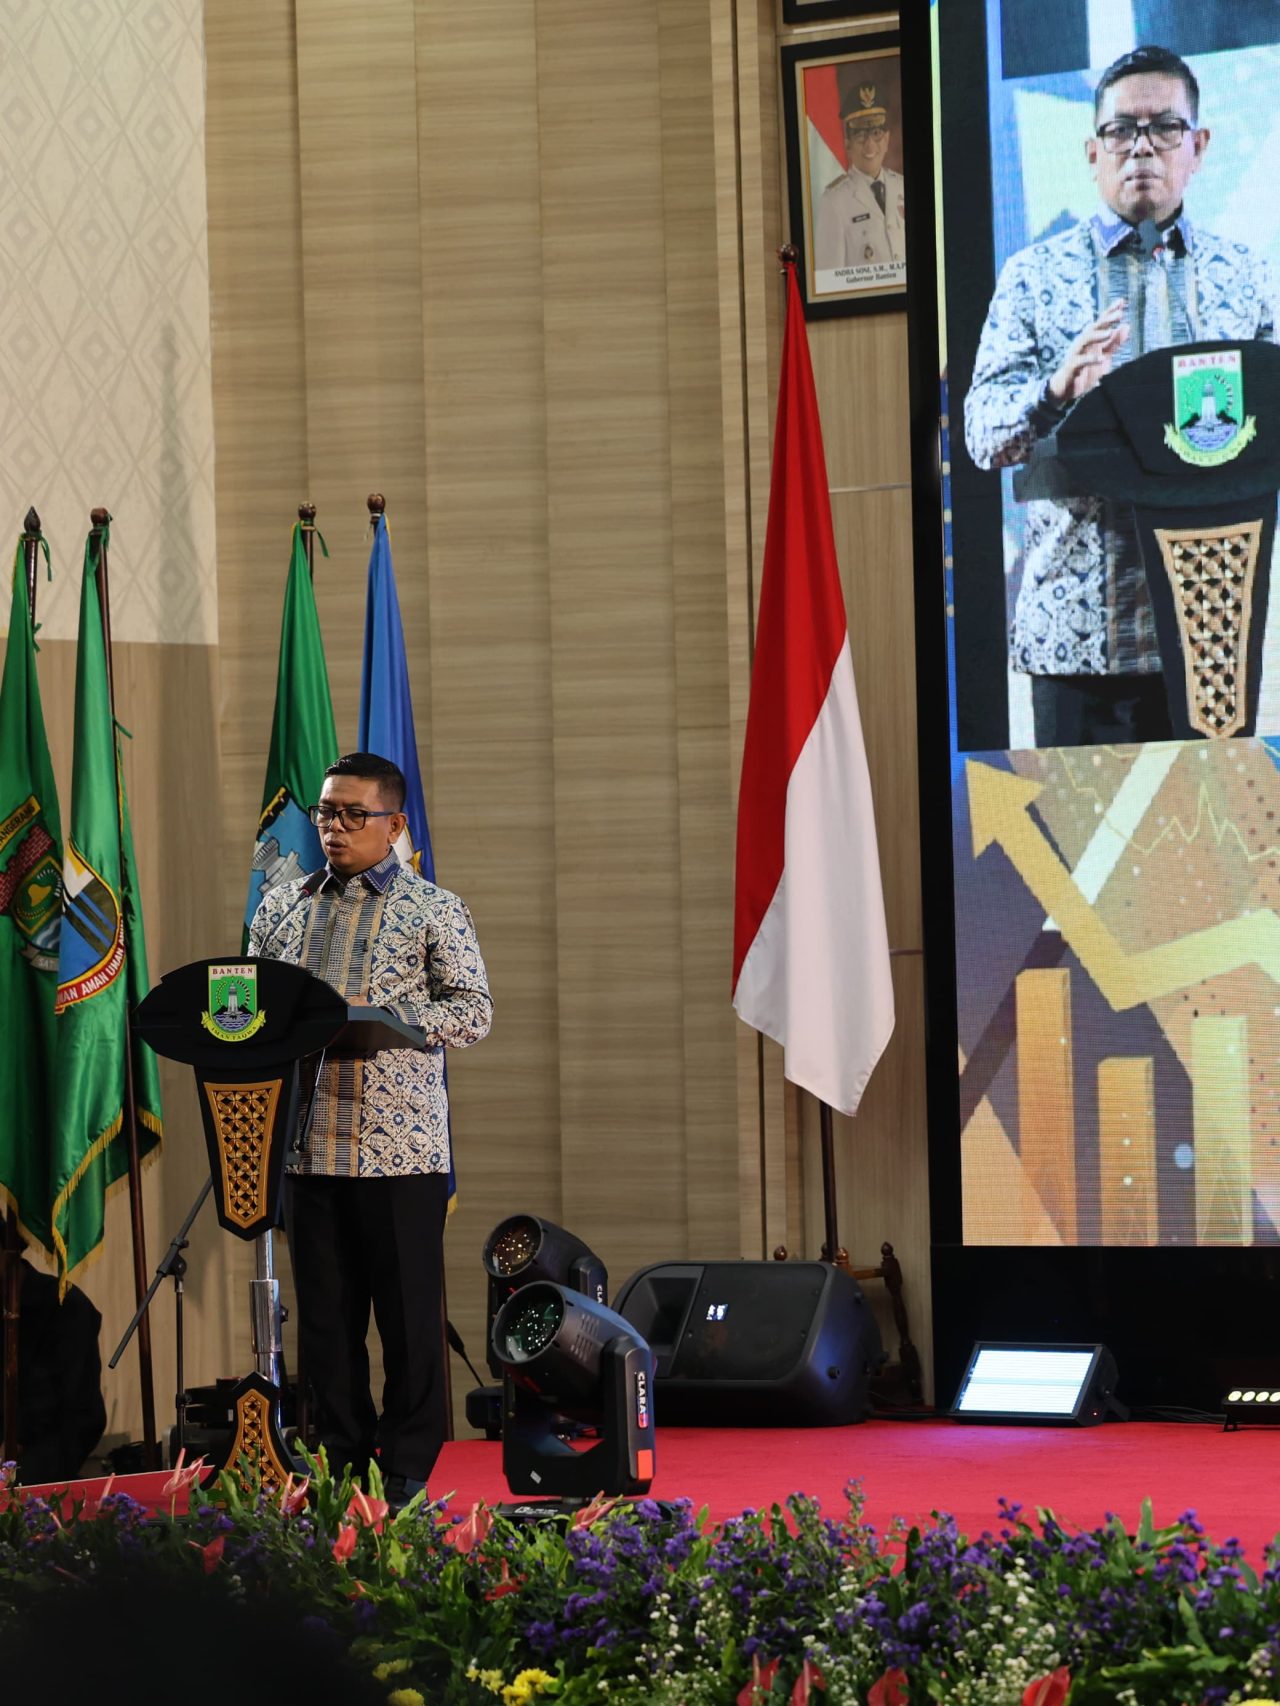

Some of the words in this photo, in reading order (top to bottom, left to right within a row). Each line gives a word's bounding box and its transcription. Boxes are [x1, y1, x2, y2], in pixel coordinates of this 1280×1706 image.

[212, 967, 253, 975] BANTEN
[80, 972, 110, 996] AMAN
[637, 1372, 648, 1415] CLARA
